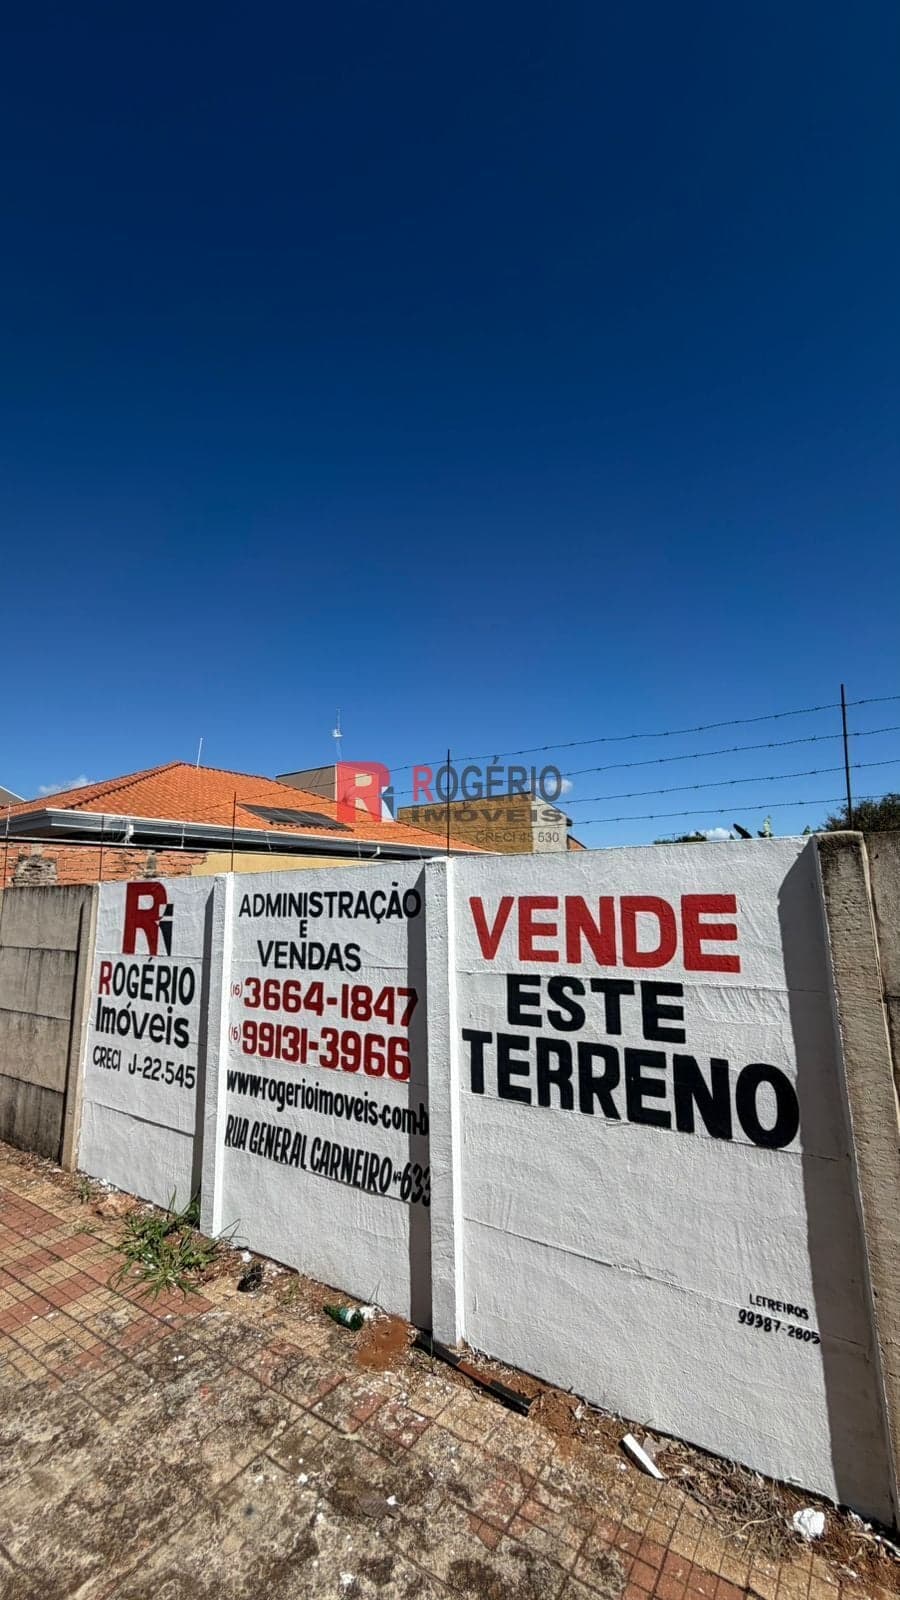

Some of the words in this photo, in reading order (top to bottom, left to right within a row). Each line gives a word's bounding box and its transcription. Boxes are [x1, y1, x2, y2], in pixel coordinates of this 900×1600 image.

[238, 882, 422, 924] ADMINISTRAÇÃO
[300, 919, 308, 938] E
[469, 894, 741, 973] VENDE
[257, 940, 362, 972] VENDAS
[98, 957, 196, 1006] ROGÉRIO
[244, 977, 418, 1028] 3664-1847
[95, 997, 190, 1049] Imóveis
[506, 973, 686, 1044] ESTE
[92, 1045, 122, 1072] CRECI
[128, 1054, 196, 1090] J-22.545
[242, 1020, 411, 1082] 99131-3966
[461, 1028, 800, 1149] TERRENO
[224, 1114, 249, 1151] RUA
[249, 1121, 307, 1170] GENERAL
[310, 1137, 393, 1194] CARNEIRO
[738, 1309, 821, 1344] 99387-2805
[749, 1293, 809, 1321] LETREIROS
